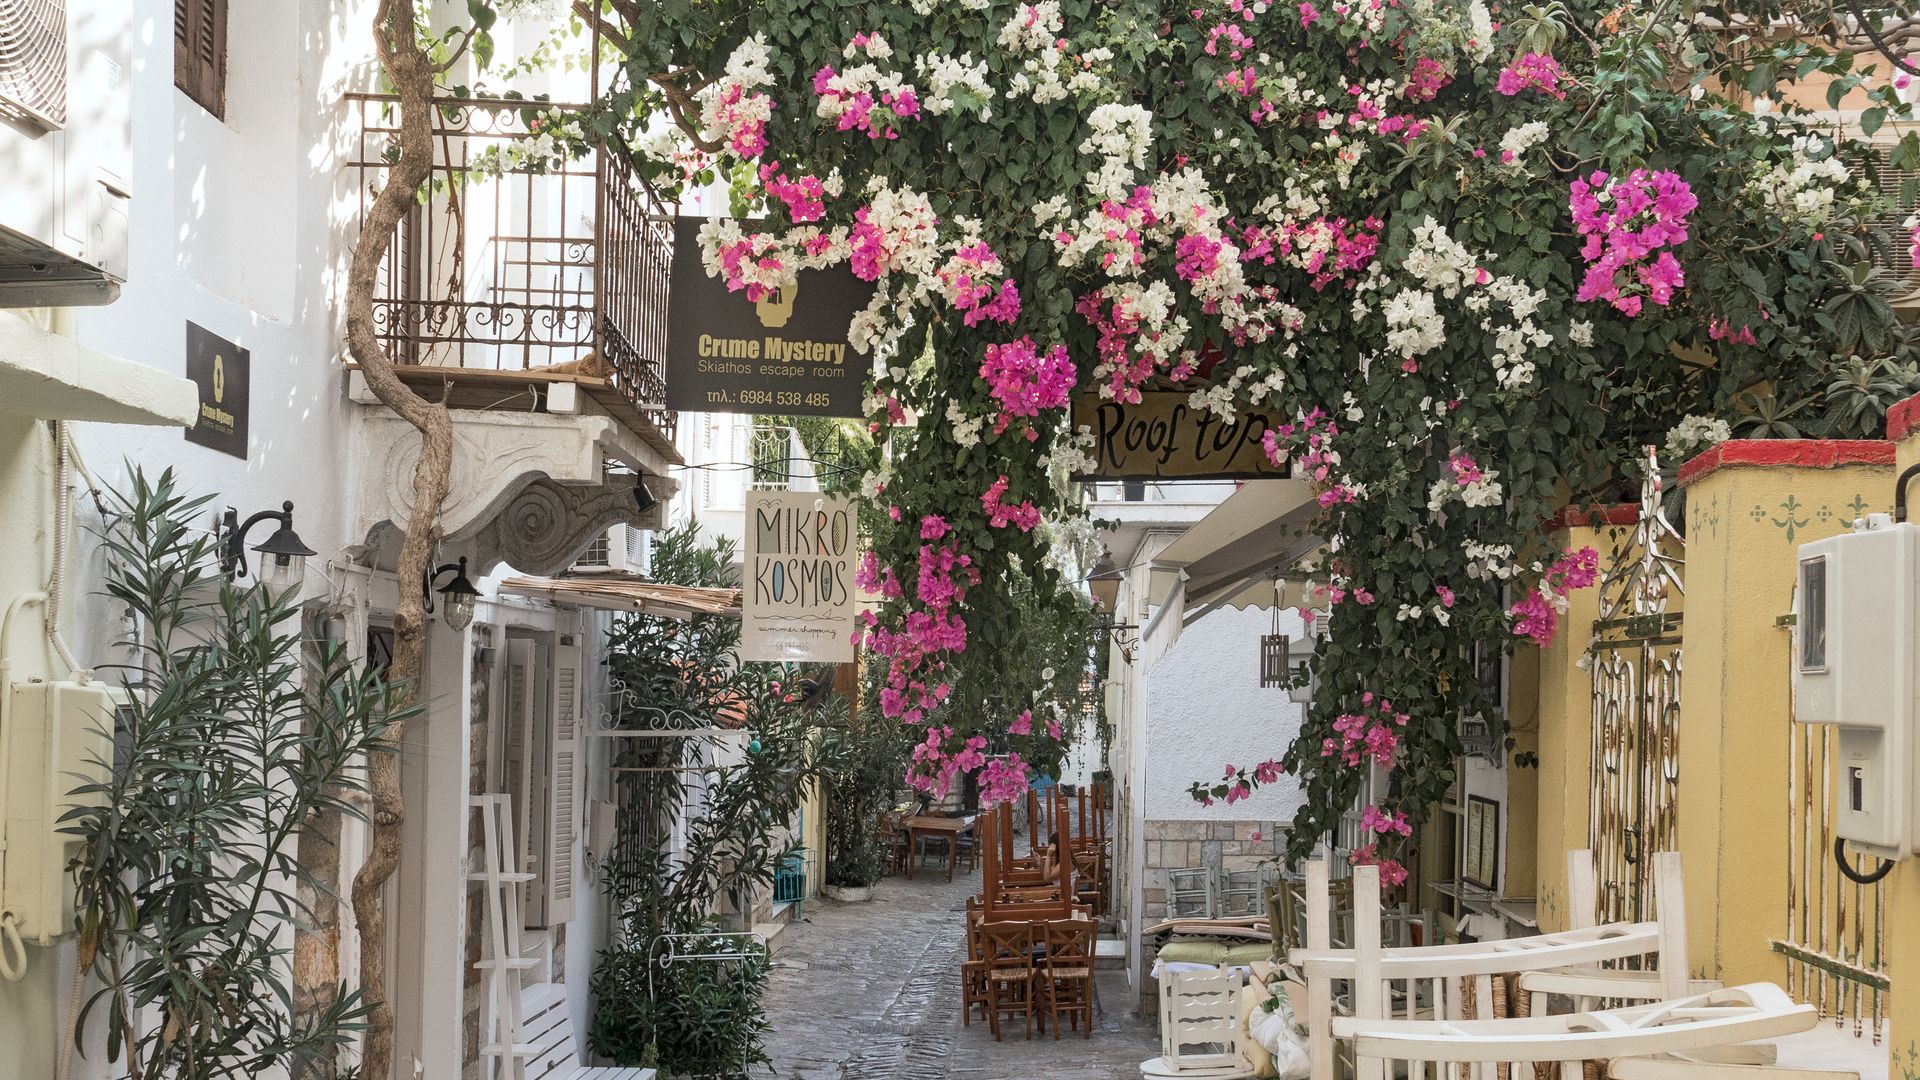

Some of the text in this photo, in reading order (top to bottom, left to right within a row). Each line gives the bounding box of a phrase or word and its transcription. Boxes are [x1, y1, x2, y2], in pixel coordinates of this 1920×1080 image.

[764, 337, 846, 365] Mystery
[698, 359, 845, 378] Skiathos escape room
[740, 390, 772, 404] 6984
[776, 392, 801, 405] 538
[805, 393, 830, 406] 485
[1097, 403, 1269, 470] Roof top
[757, 507, 848, 557] MIKRO
[755, 556, 847, 608] KOSMOS
[800, 626, 836, 640] shopping
